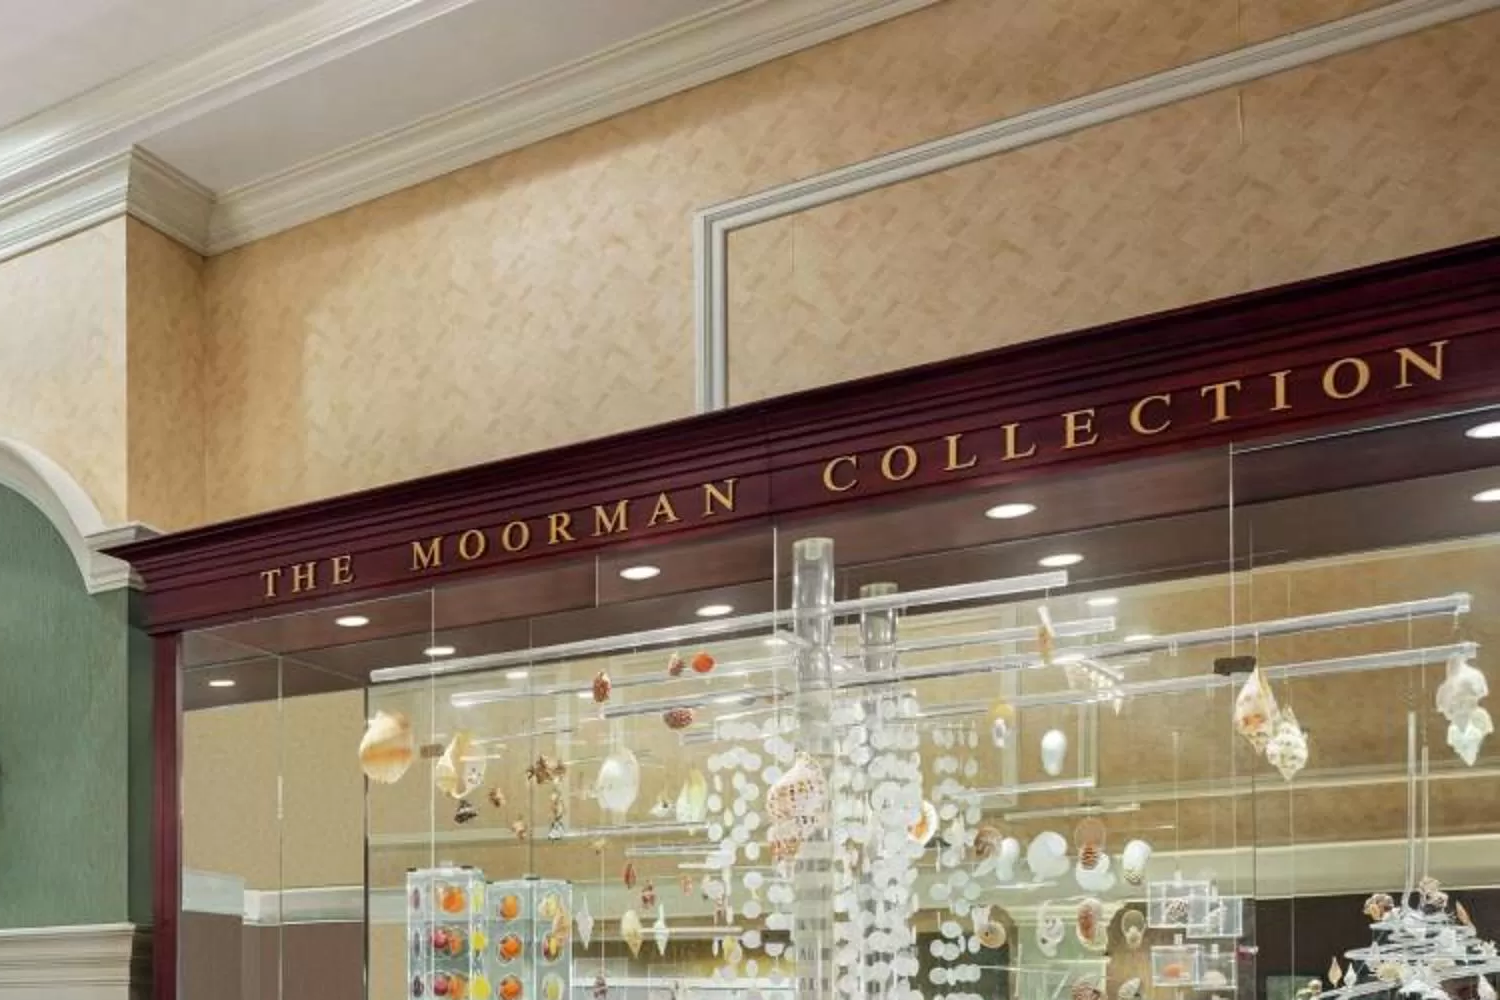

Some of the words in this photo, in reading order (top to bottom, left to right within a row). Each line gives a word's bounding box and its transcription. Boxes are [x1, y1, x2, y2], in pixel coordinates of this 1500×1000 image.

[260, 554, 356, 598] THE
[410, 478, 739, 570] MOORMAN
[822, 340, 1450, 493] COLLECTION
